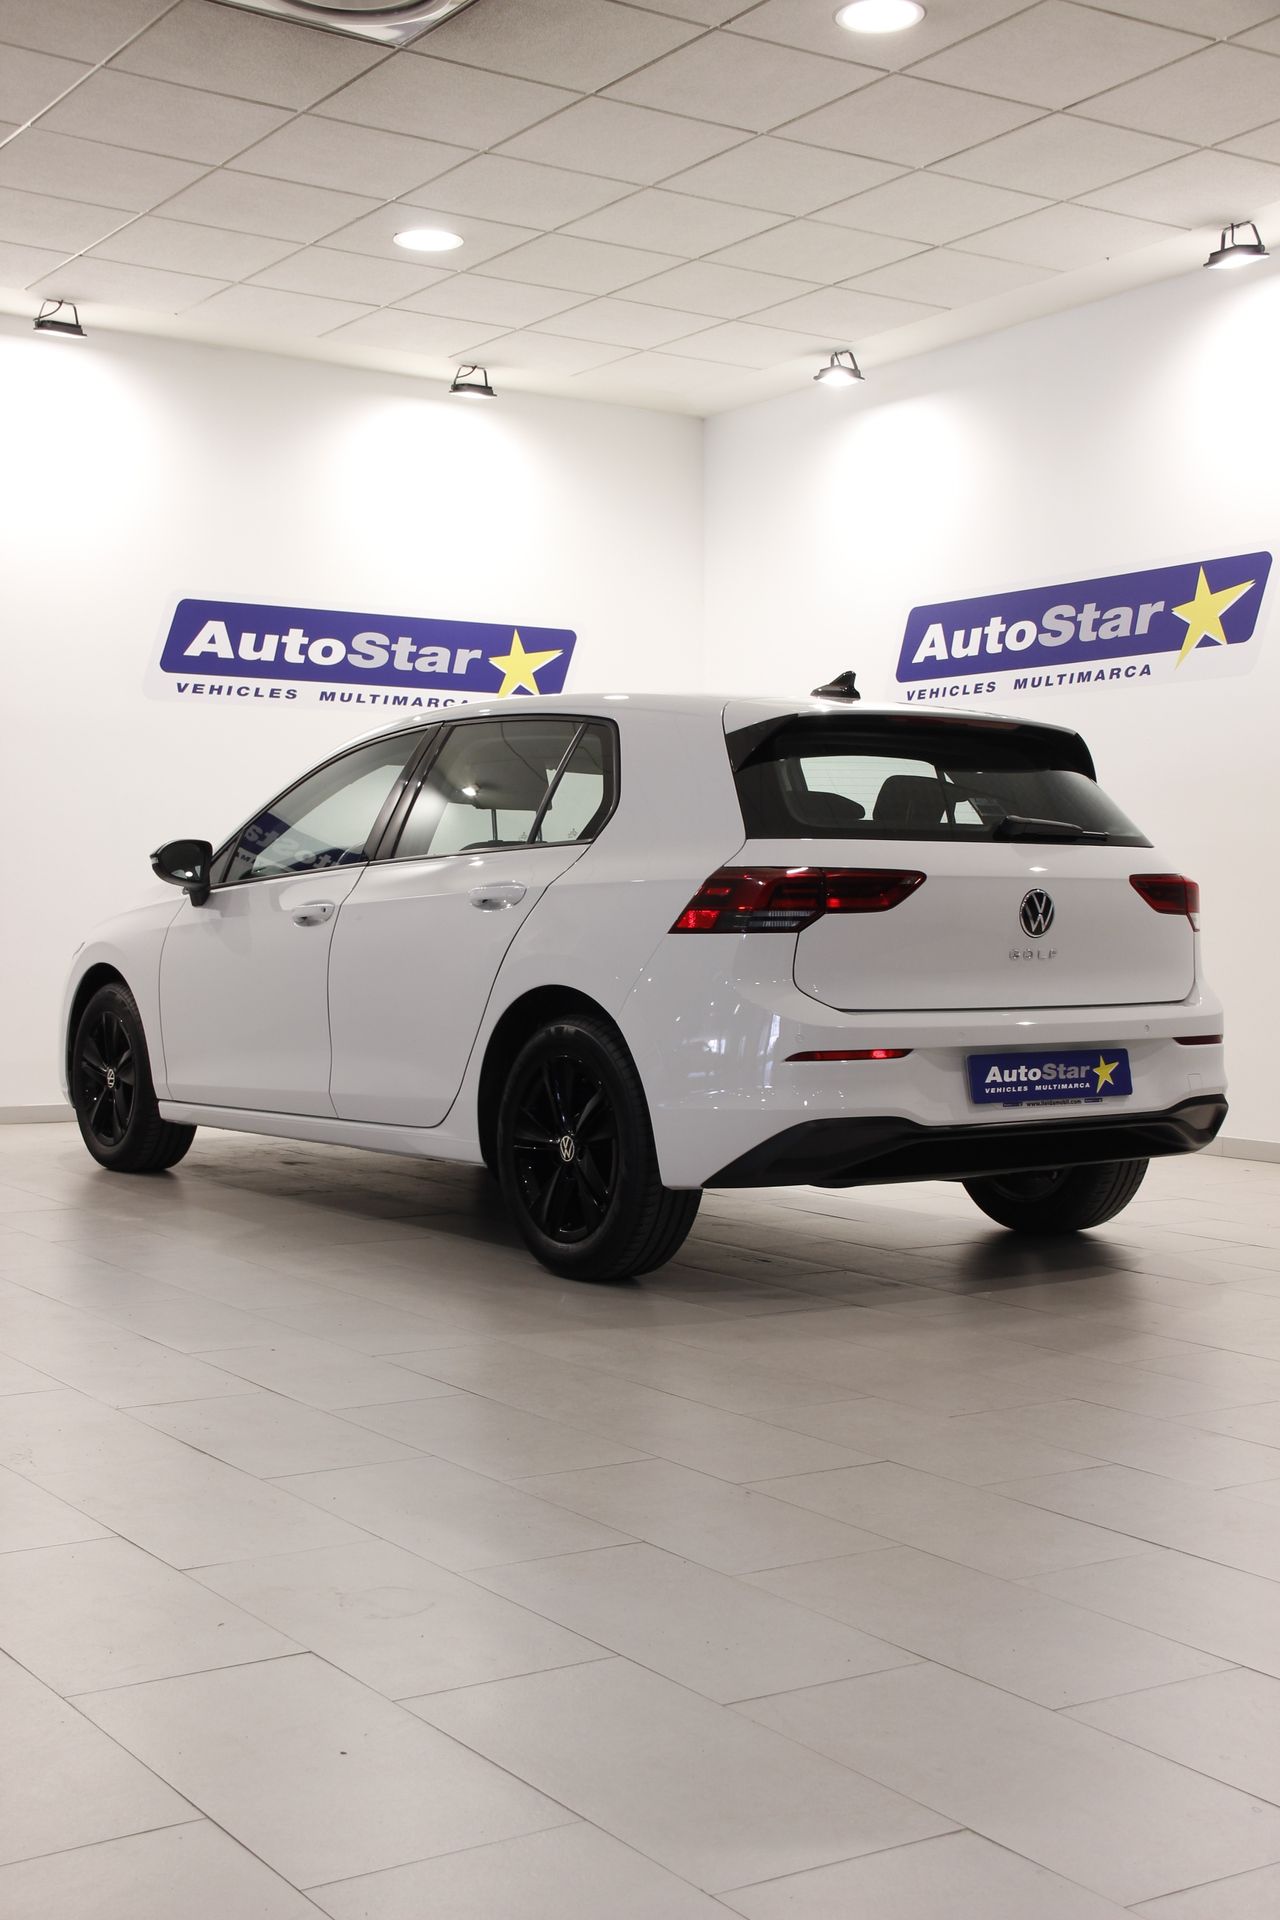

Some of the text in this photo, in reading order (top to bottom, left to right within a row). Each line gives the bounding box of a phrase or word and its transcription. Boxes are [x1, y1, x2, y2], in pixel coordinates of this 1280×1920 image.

[911, 600, 1165, 664] AutoStar
[183, 619, 482, 675] AutoStar
[176, 682, 298, 700] VEHICLES
[906, 664, 1152, 701] VEHICLES MULTIMARCA
[1008, 948, 1058, 961] GOLF
[985, 1063, 1090, 1083] AutoStar
[985, 1082, 1091, 1094] VEHICLES MULTIMARCA
